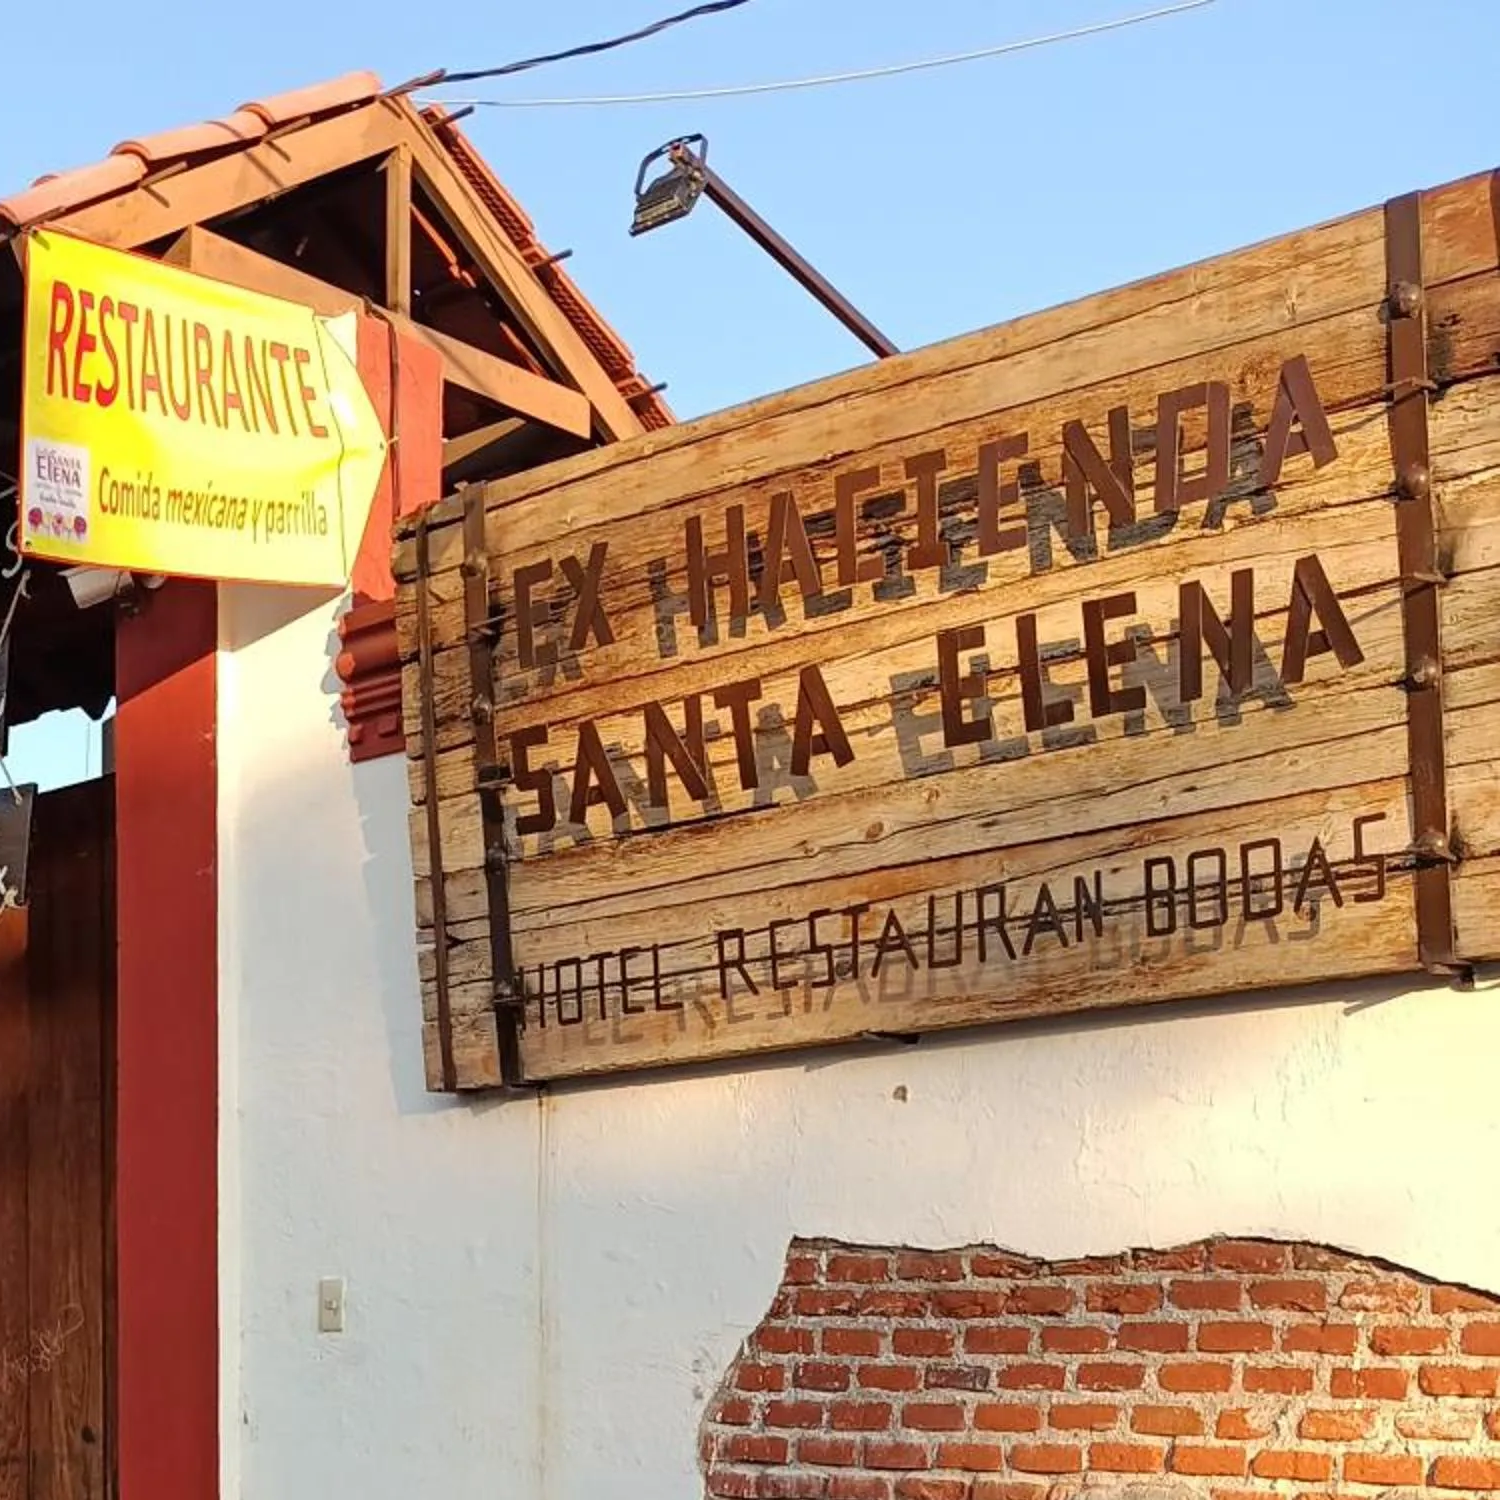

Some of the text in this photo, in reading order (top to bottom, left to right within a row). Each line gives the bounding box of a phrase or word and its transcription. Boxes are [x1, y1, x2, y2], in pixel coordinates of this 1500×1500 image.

[46, 281, 329, 438] RESTAURANTE
[99, 464, 329, 544] Comida mexicana y parrilla
[514, 353, 1339, 670] EX HACIENDA
[510, 553, 1365, 836] SANTA ELENA
[518, 812, 1387, 1028] HOTEL RESTAURAN BODAS
